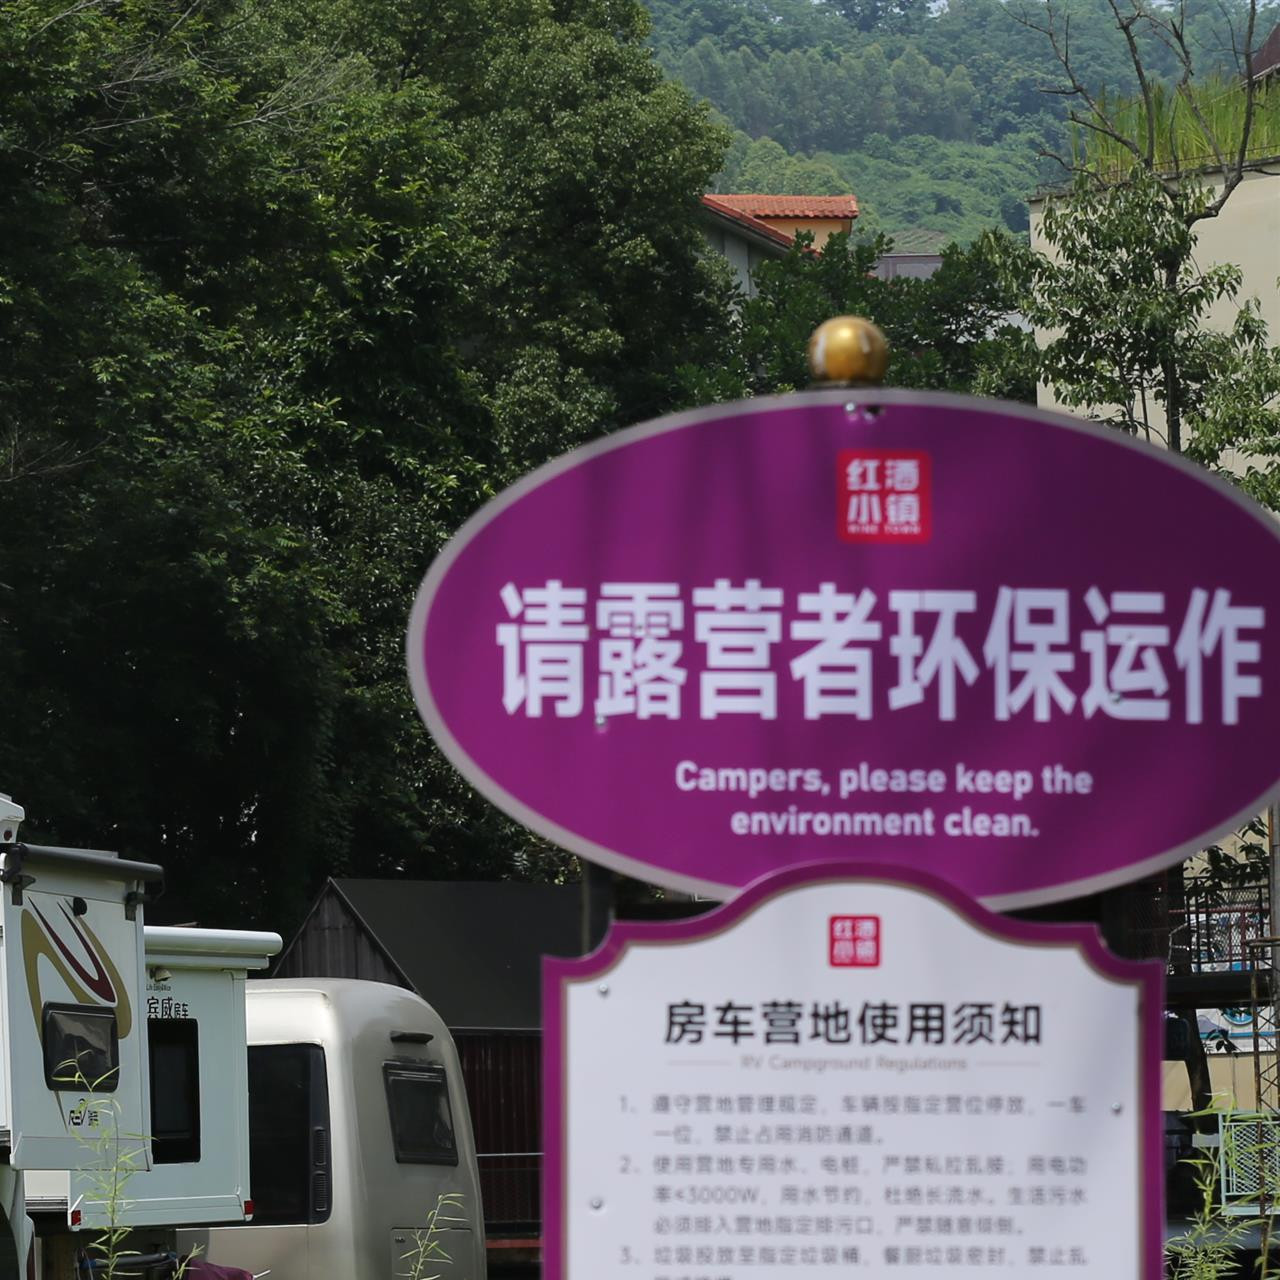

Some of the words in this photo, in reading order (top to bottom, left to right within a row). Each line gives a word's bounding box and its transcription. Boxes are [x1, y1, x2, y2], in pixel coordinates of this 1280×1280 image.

[846, 459, 920, 491] 红酒
[847, 493, 921, 524] 小镇
[496, 580, 1264, 725] 请露营者环保运作
[676, 761, 830, 797] Campers,
[842, 761, 946, 799] please
[956, 764, 1033, 799] keep
[1041, 766, 1093, 794] the
[731, 808, 934, 837] environment
[944, 808, 1040, 837] clean.
[664, 1001, 1042, 1045] 房车营地使用须知
